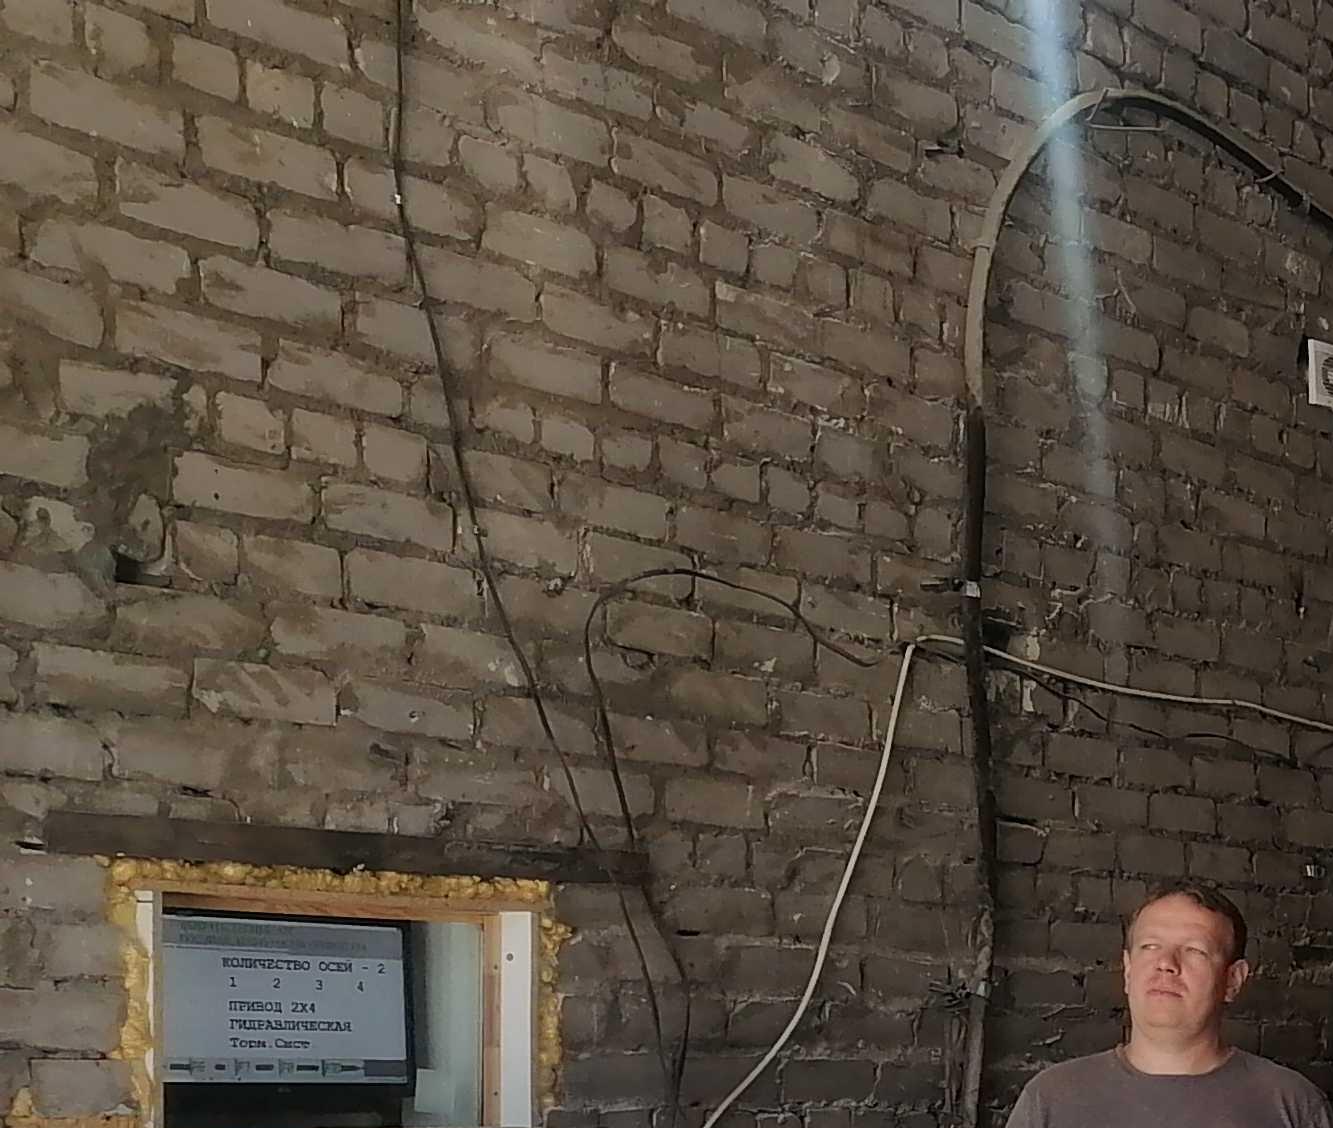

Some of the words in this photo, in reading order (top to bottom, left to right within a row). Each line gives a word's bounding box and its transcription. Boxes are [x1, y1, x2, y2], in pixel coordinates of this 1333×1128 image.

[222, 956, 311, 972] КОЛИЧЕСТВО
[319, 958, 353, 973] ОСЕЙ
[377, 963, 386, 975] 2
[229, 976, 237, 988] 1
[273, 978, 281, 989] 2
[315, 979, 323, 991] 3
[356, 981, 365, 992] 4
[228, 1000, 283, 1014] ПРИВОД
[229, 1018, 353, 1033] ГИДРАВЛИЧЕСКАЯ
